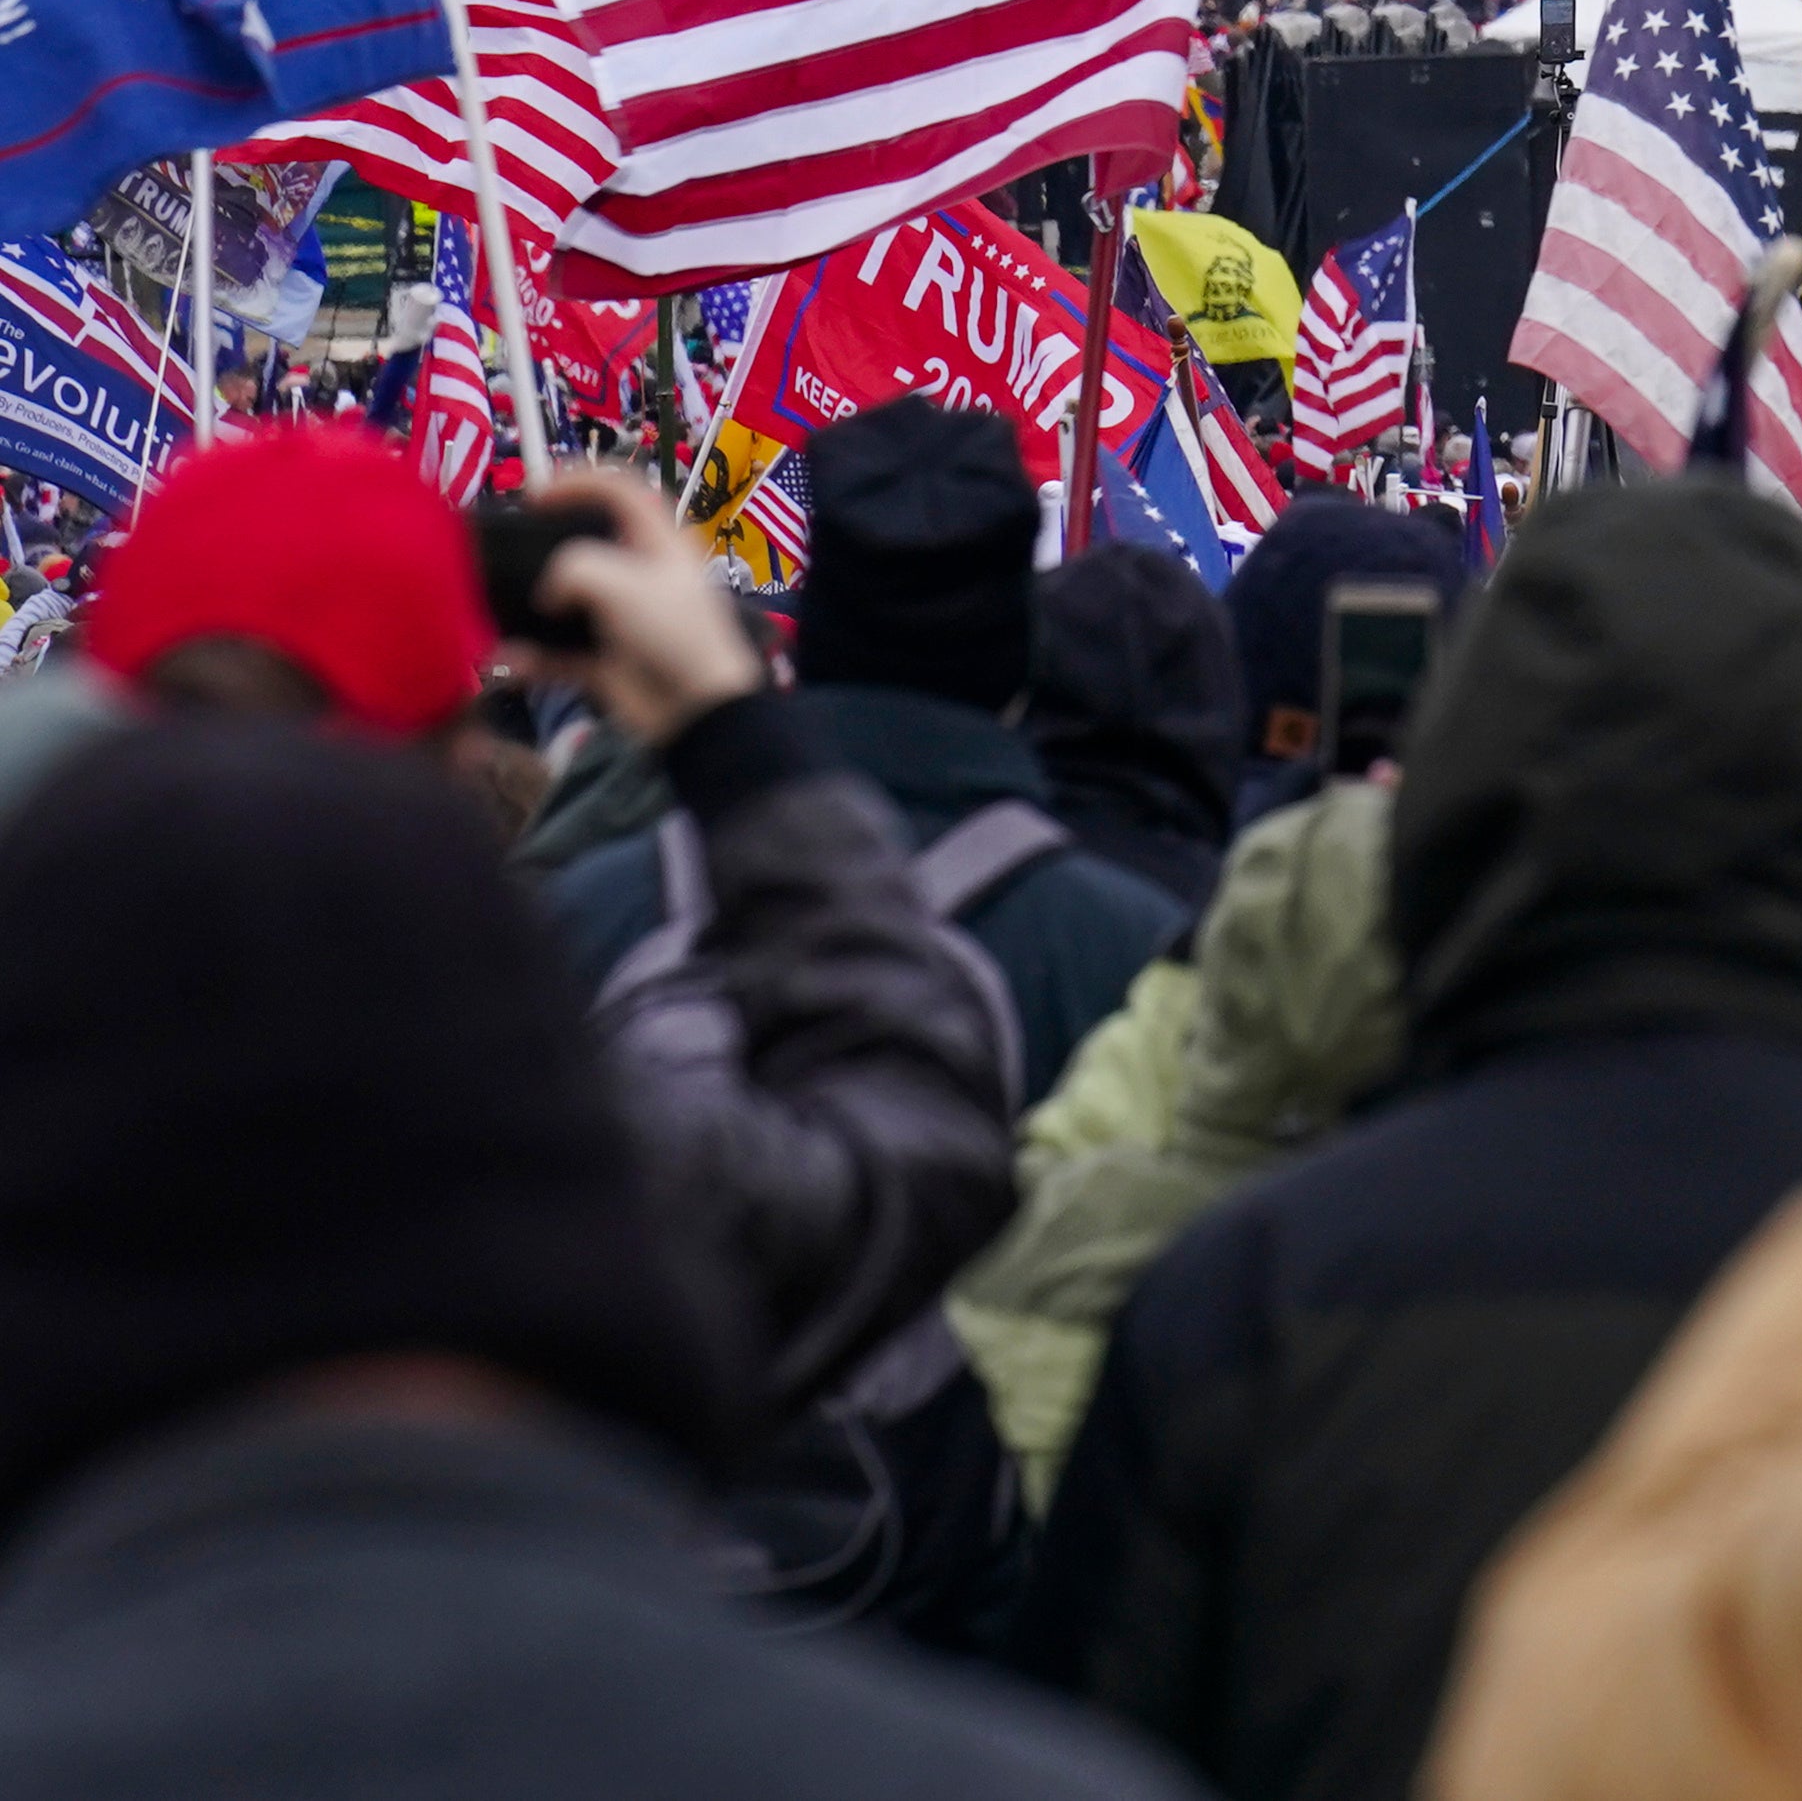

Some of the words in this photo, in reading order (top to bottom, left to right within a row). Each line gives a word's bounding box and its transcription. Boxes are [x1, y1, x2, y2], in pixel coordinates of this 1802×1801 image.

[856, 212, 1135, 432] TRUMP
[794, 366, 858, 423] KEEP
[15, 402, 74, 440] Producers,
[78, 432, 129, 473] Protecting
[15, 441, 31, 455] Go
[32, 448, 54, 463] and
[54, 457, 83, 476] claim
